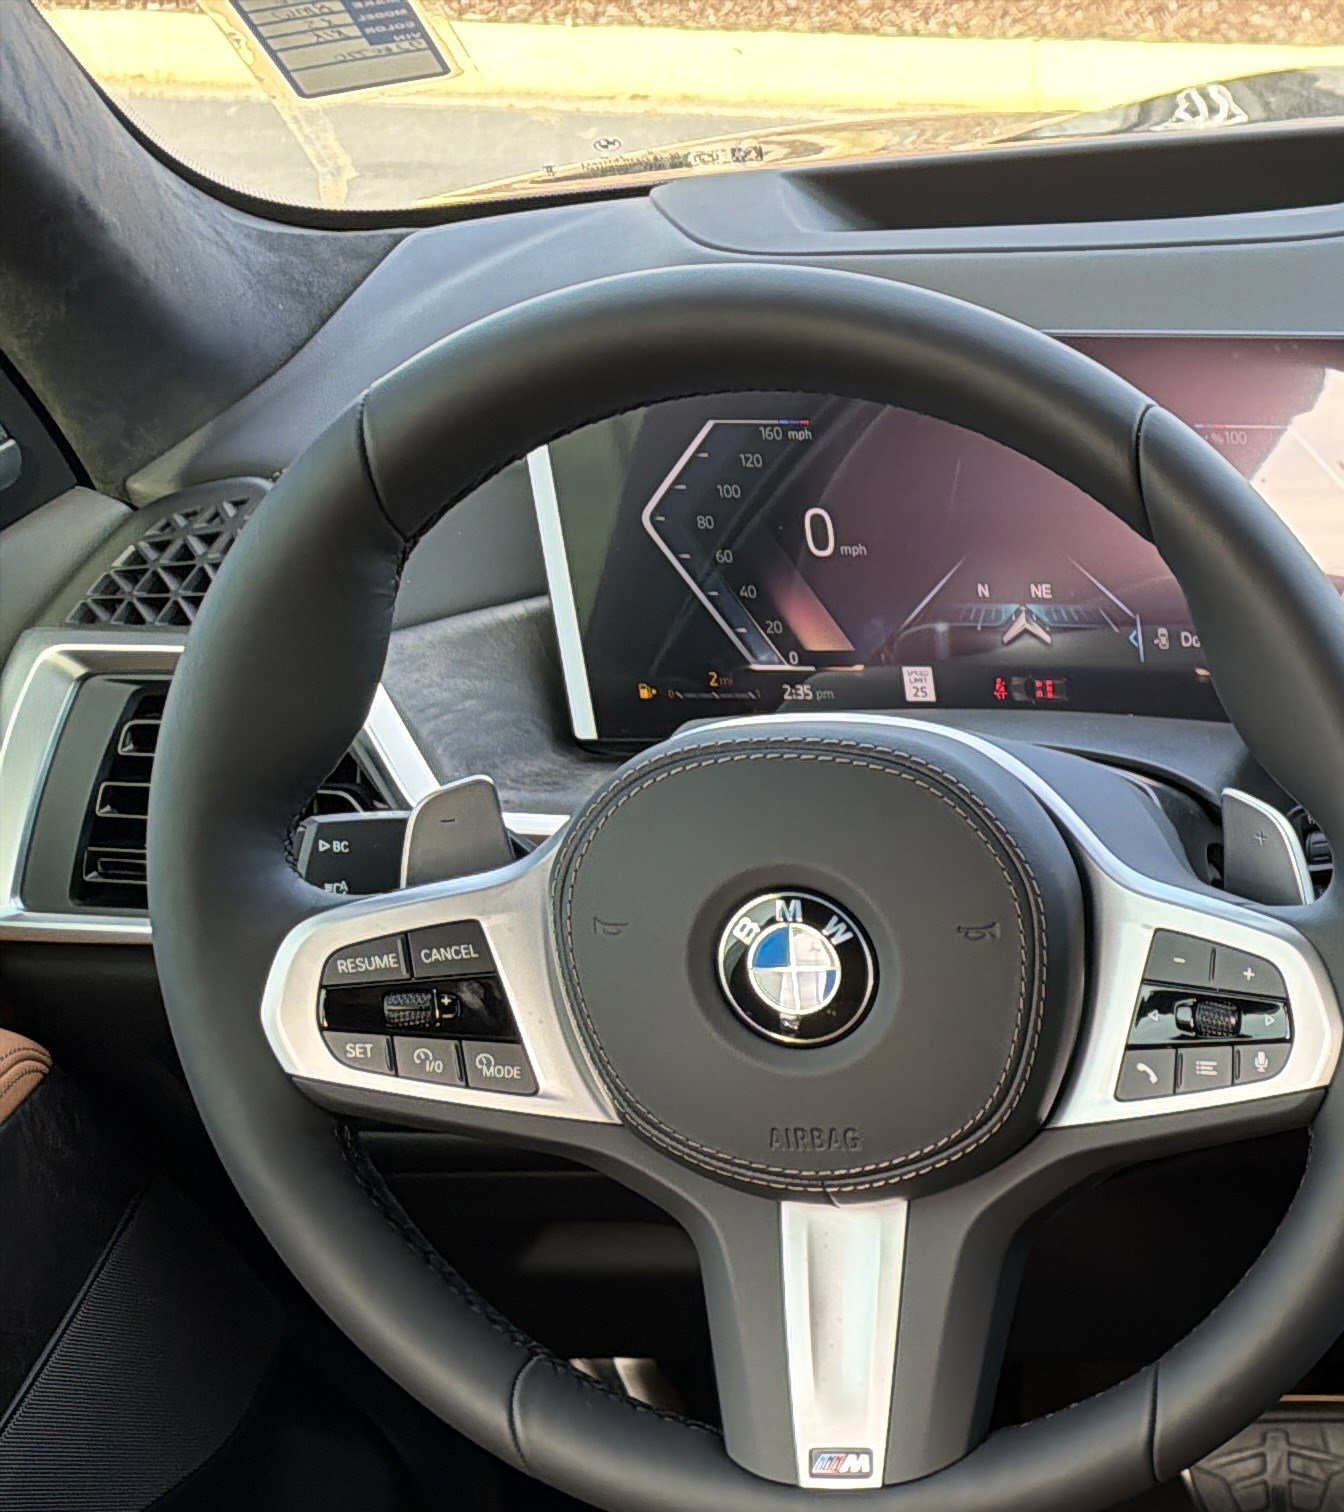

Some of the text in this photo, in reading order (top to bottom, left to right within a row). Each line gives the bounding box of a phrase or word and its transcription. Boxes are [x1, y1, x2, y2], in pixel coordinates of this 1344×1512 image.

[759, 426, 813, 441] 160 mph
[739, 453, 763, 468] 120
[716, 484, 741, 499] 100
[697, 515, 714, 530] 80
[804, 507, 867, 558] 0 mph
[715, 549, 733, 564] 60
[739, 585, 757, 599] 40
[977, 583, 990, 598] N
[1030, 583, 1053, 598] NE
[765, 620, 783, 634] 20
[788, 651, 799, 665] 0
[707, 671, 719, 687] 2
[782, 684, 834, 701] 2:35 pm
[913, 686, 928, 698] 25
[333, 840, 350, 852] BC
[732, 899, 853, 946] BMW
[421, 944, 479, 964] CANCEL
[337, 953, 399, 974] RESUME
[346, 1043, 373, 1059] SET
[482, 1065, 522, 1079] MODE
[769, 1127, 861, 1151] AIRBAG
